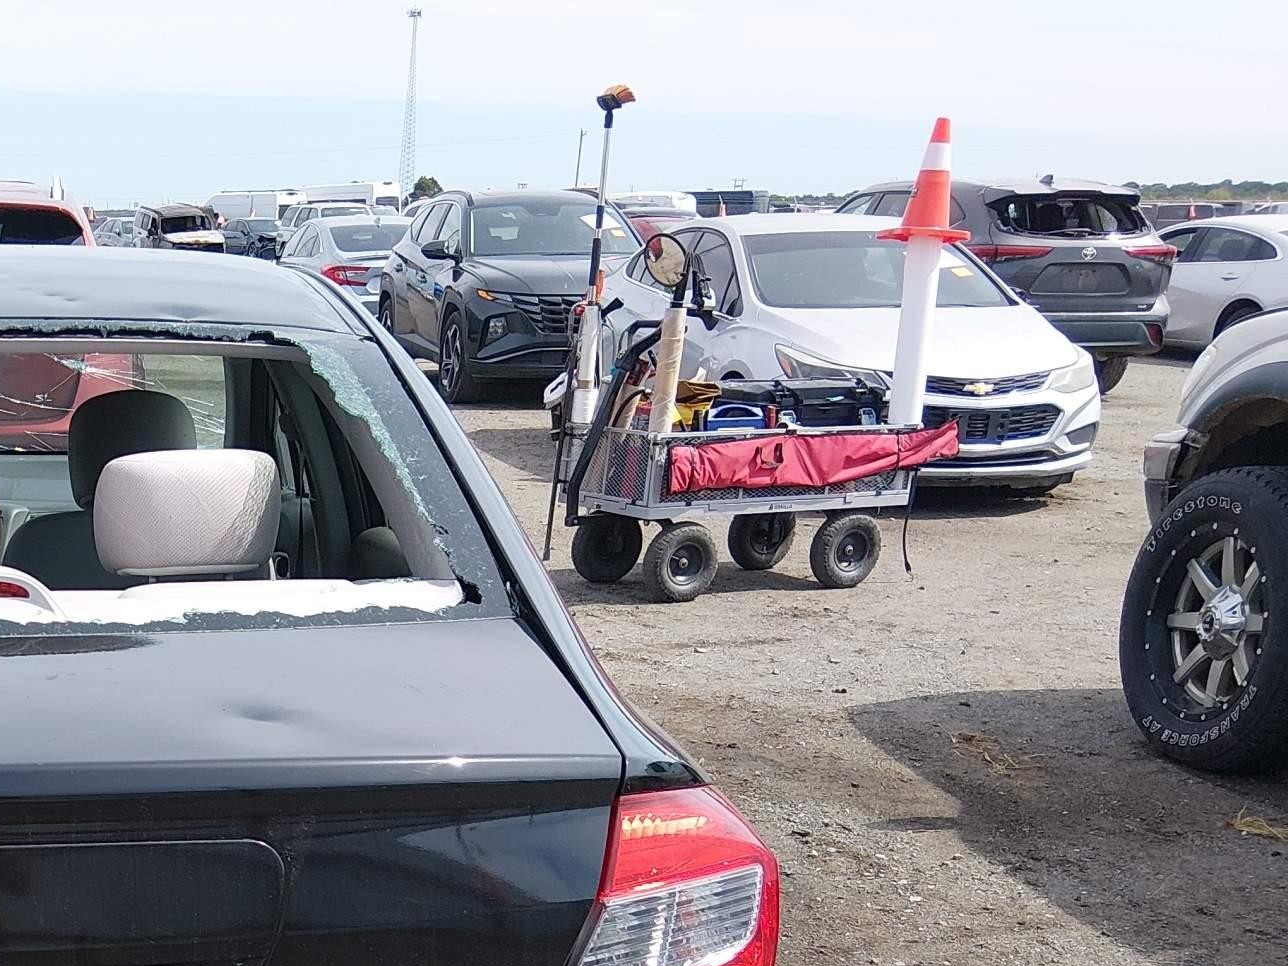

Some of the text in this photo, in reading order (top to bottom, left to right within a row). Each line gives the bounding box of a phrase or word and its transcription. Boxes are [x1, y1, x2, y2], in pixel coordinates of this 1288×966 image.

[1144, 496, 1242, 552] Firestone
[1142, 684, 1257, 746] TRANSFORCE AT
